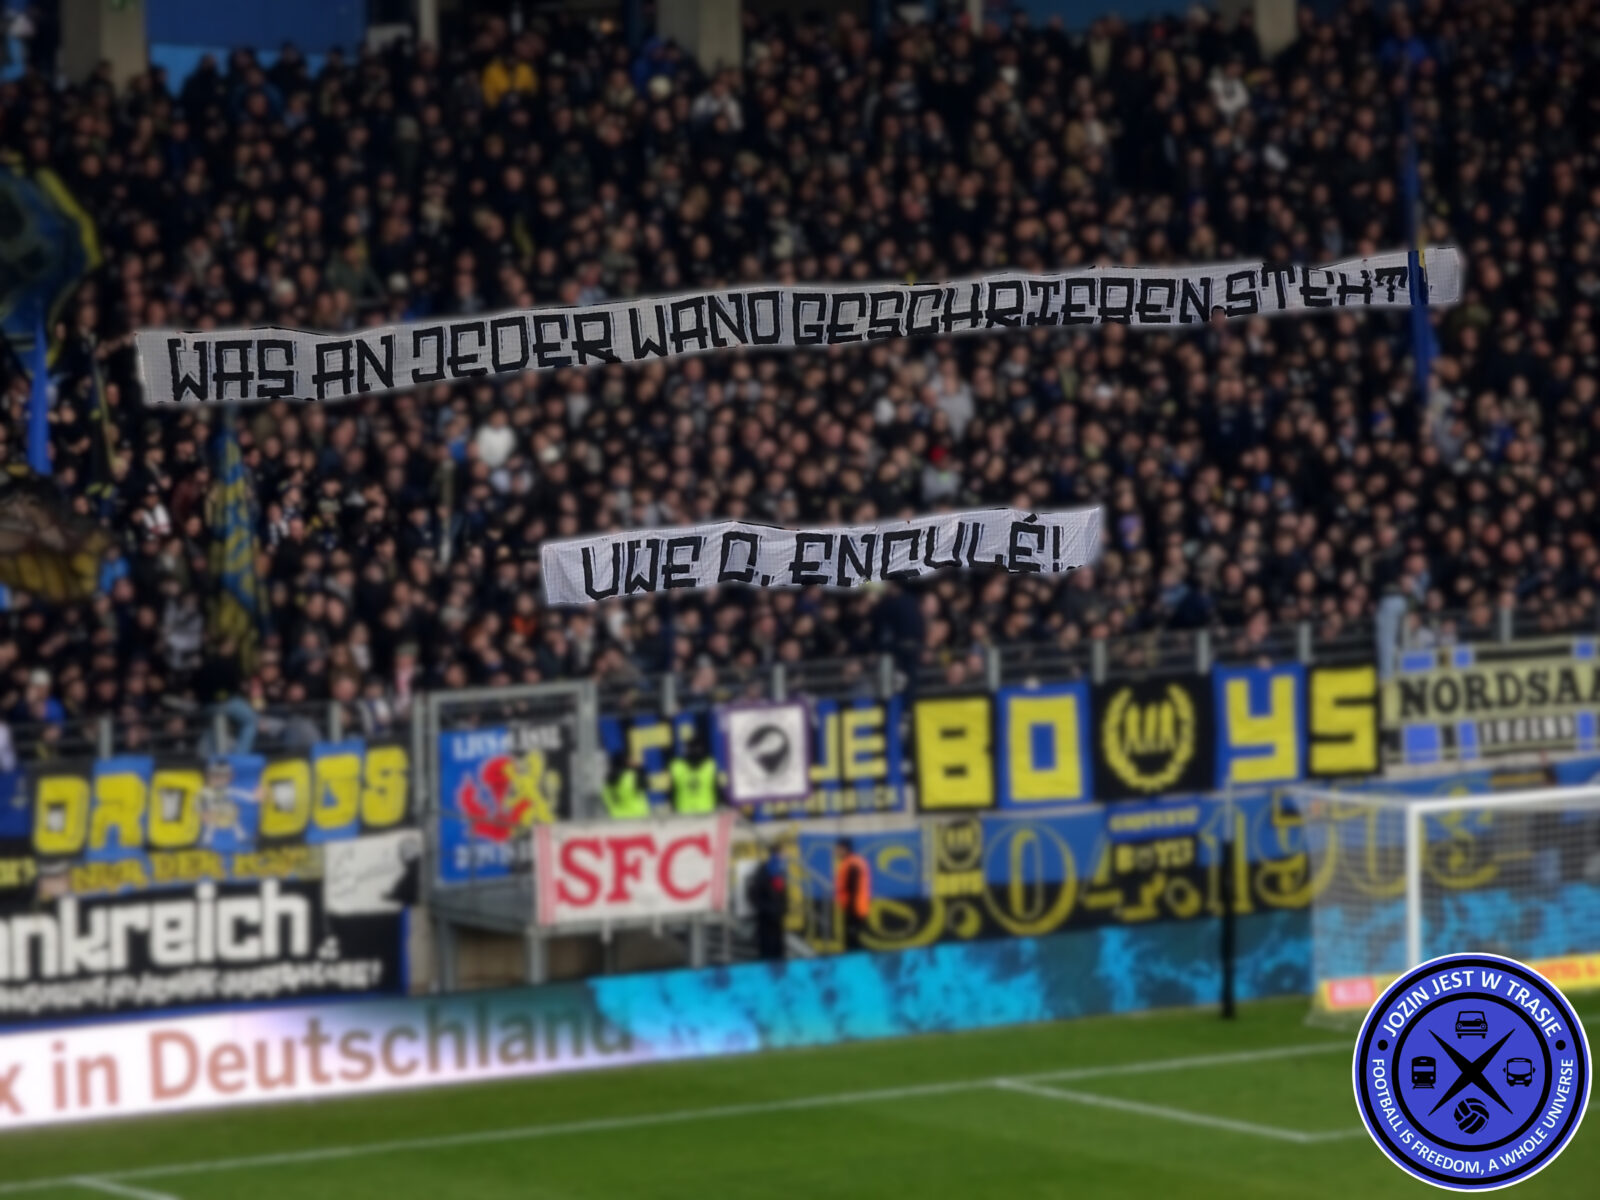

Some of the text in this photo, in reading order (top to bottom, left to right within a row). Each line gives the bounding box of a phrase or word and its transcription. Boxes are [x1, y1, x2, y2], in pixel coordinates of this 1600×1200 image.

[168, 262, 1408, 400] WAS AN JEDER WAND GESCHRIEBEN STEHT
[581, 536, 702, 600] UWE
[789, 513, 1060, 586] ENCULÉ!
[556, 831, 713, 908] SFC
[0, 878, 310, 981] nkreich
[51, 1039, 119, 1110] in
[148, 1001, 637, 1101] Deutschland
